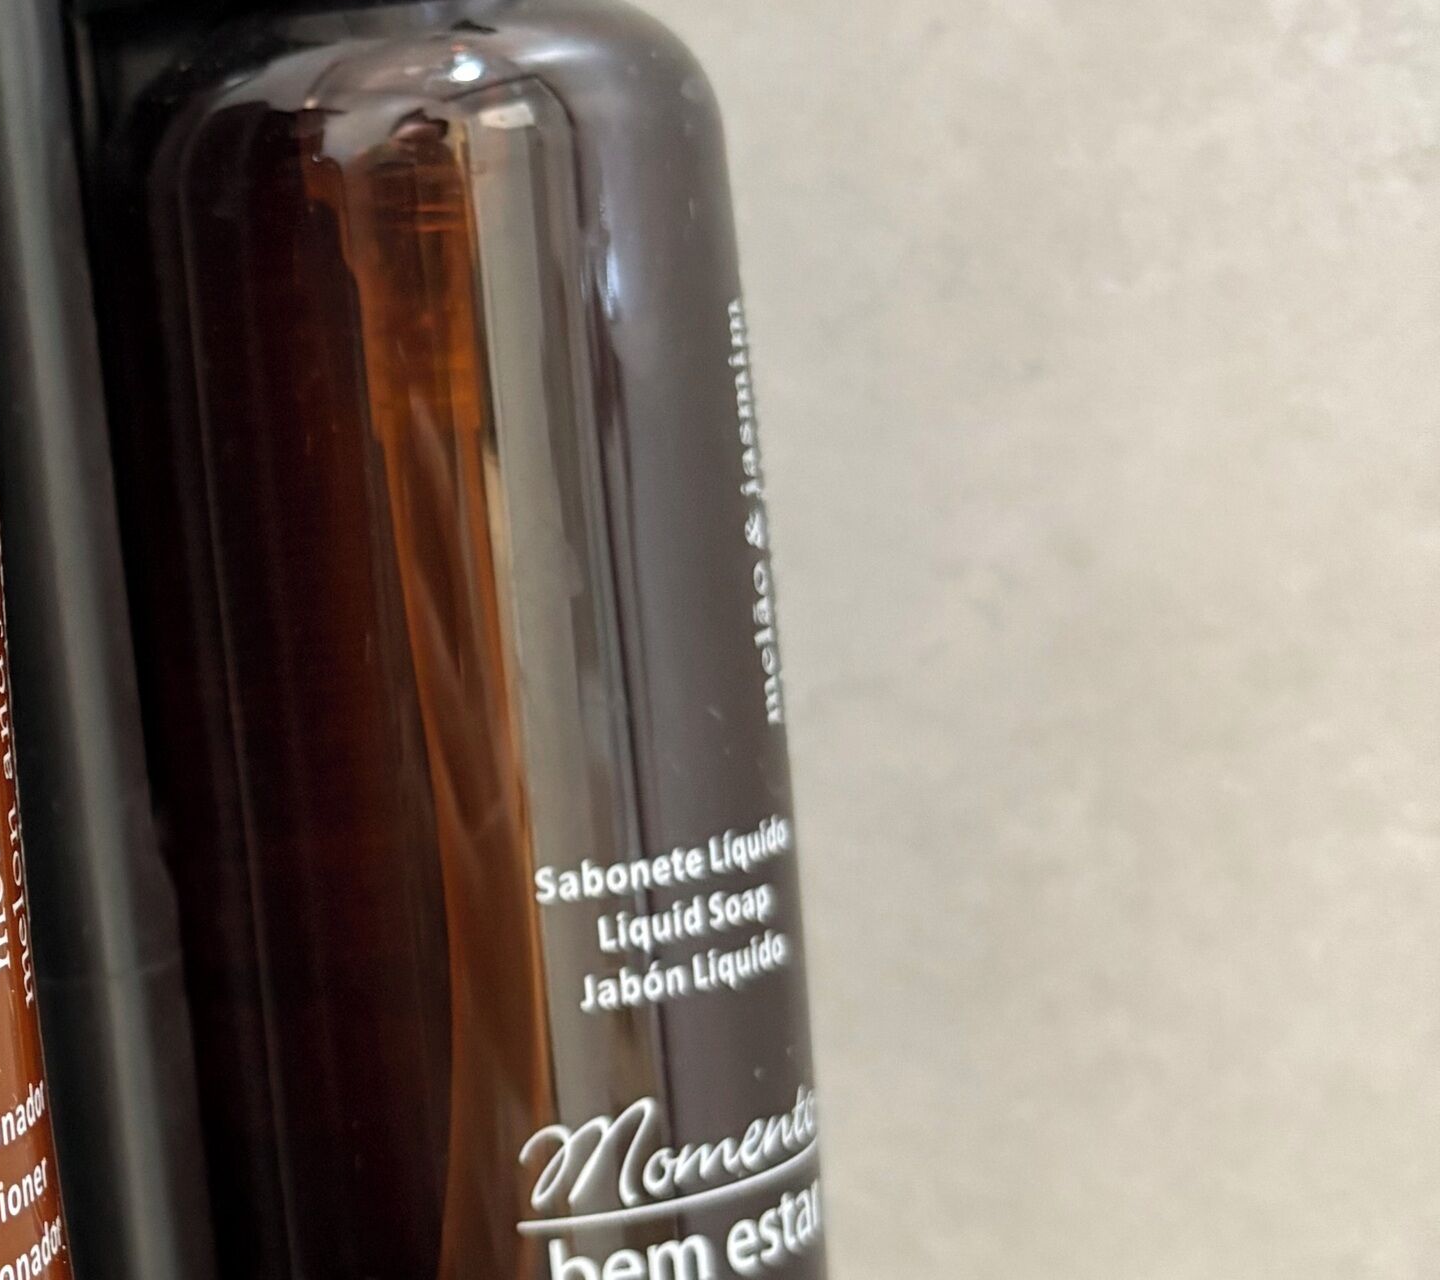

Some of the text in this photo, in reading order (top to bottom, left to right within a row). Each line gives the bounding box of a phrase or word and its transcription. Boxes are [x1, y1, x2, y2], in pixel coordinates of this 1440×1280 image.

[534, 847, 707, 905] Sabonete
[597, 883, 778, 954] Liquid Soap
[580, 959, 688, 1013] Jabón
